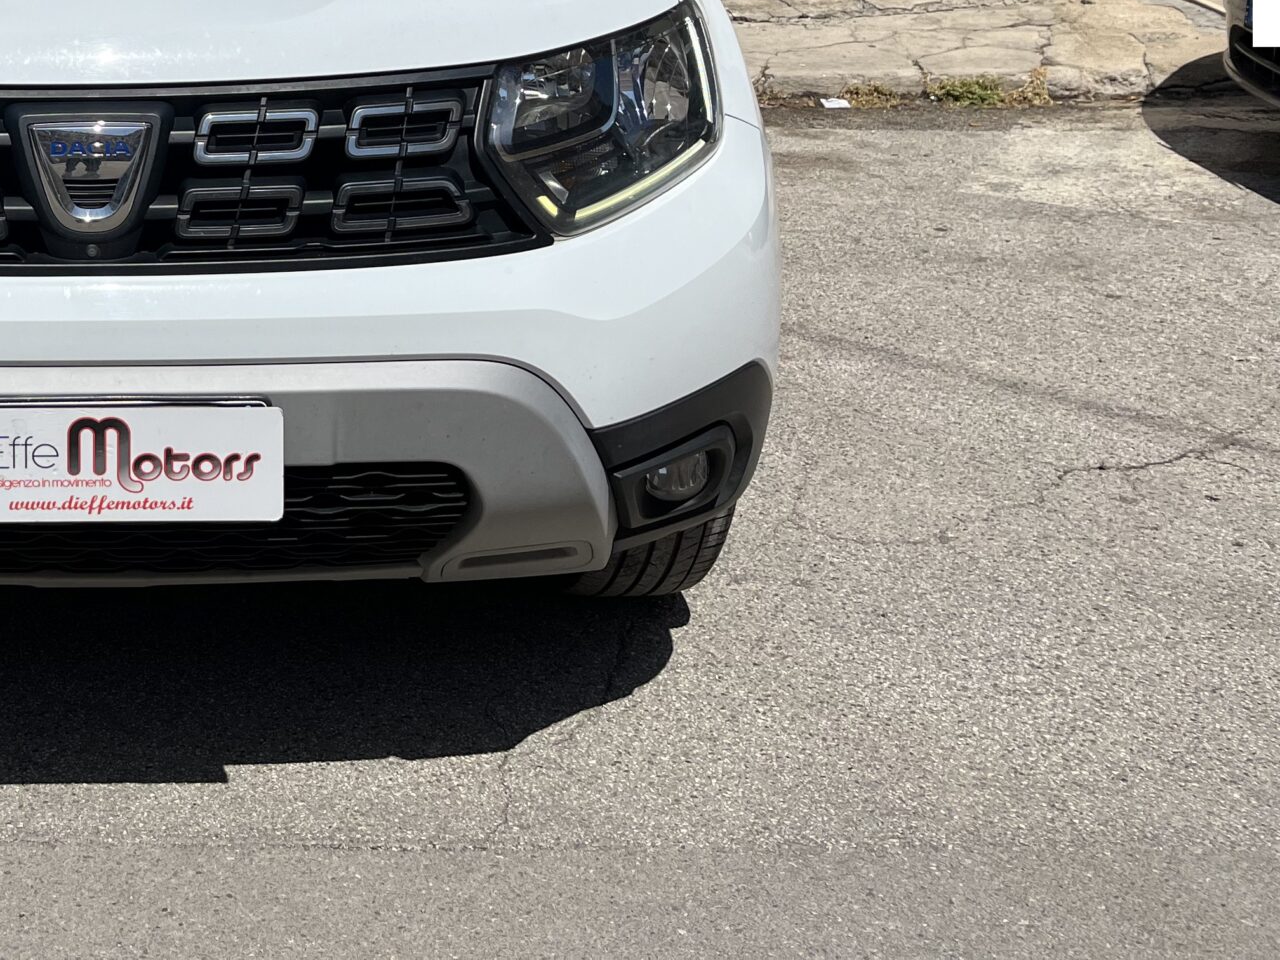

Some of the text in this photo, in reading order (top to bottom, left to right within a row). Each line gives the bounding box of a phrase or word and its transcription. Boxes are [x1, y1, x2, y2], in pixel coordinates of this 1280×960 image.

[50, 141, 131, 157] DACIA
[66, 416, 262, 494] Motors
[41, 477, 51, 489] in
[51, 477, 113, 489] movimento
[8, 494, 195, 515] www.dieffemotors.it
